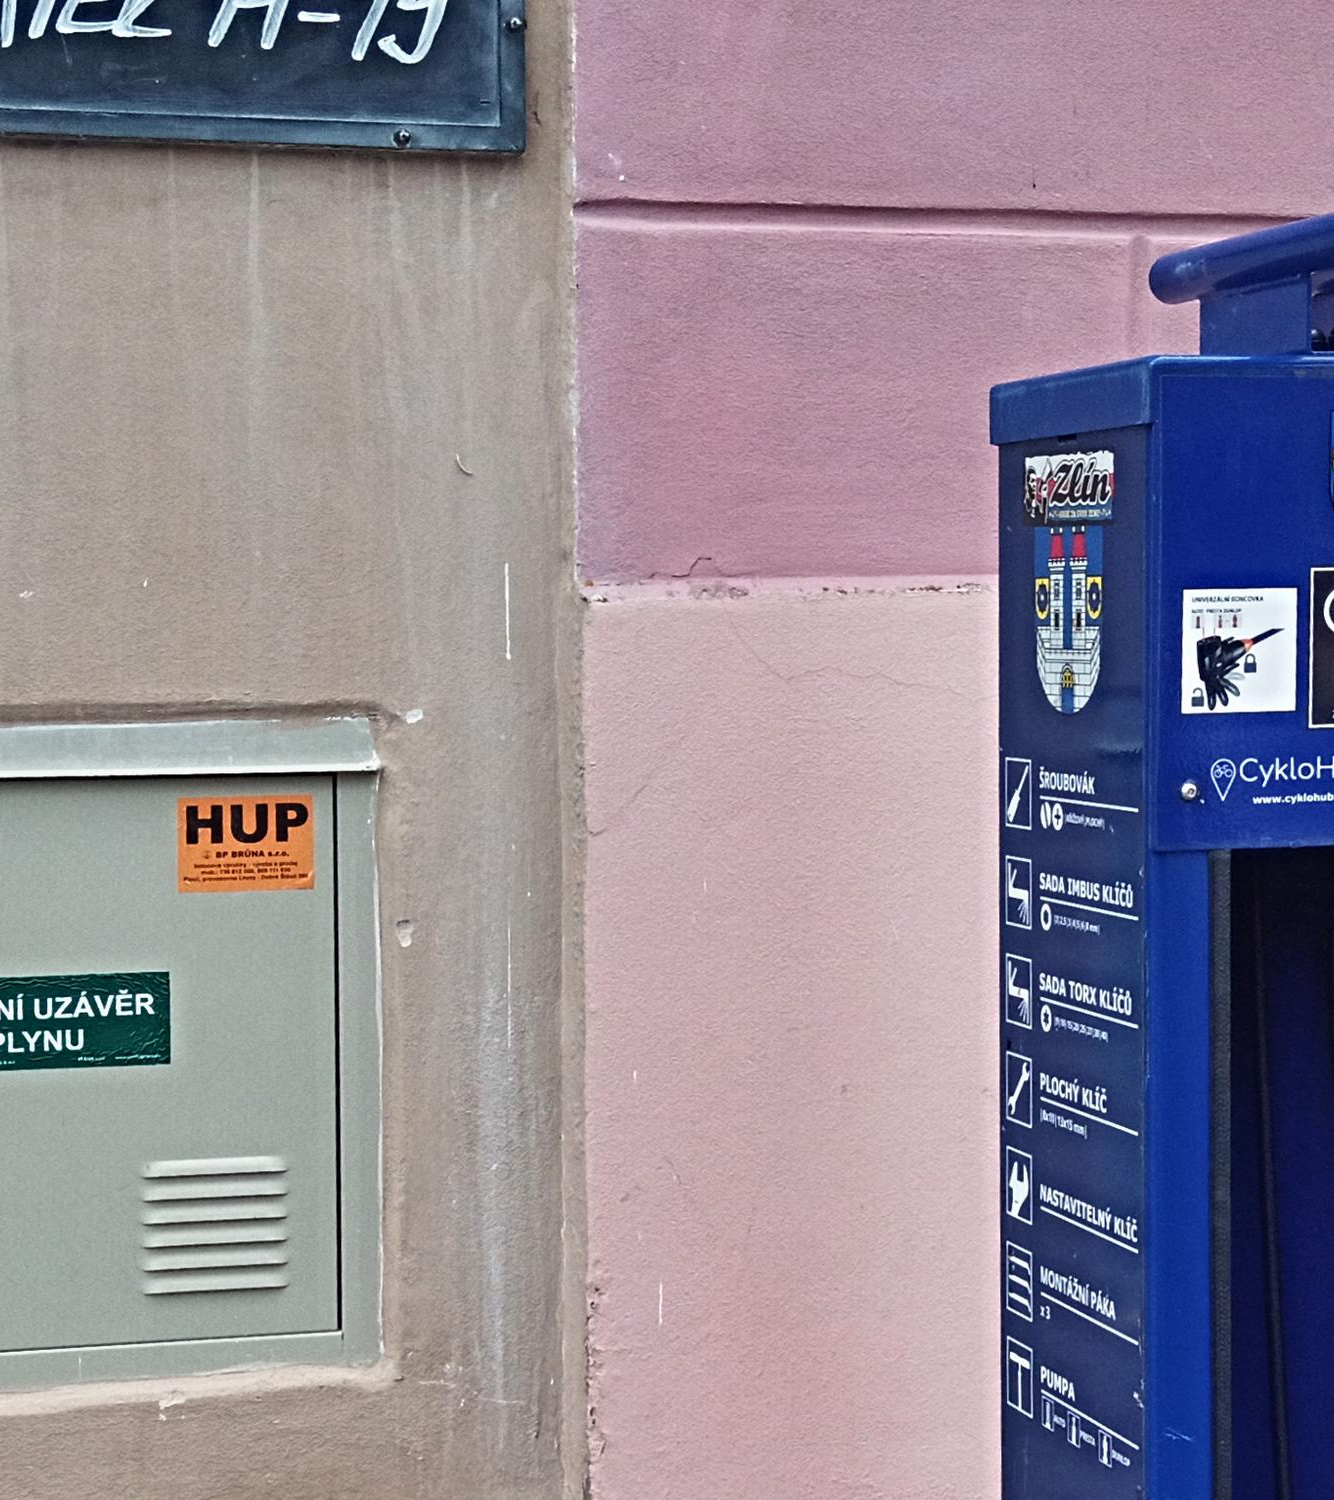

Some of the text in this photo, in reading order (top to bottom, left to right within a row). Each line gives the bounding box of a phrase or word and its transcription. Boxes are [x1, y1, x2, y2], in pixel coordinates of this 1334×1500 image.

[1050, 459, 1111, 505] Zlín
[1039, 766, 1095, 795] ŠROUBOVÁK
[185, 803, 309, 845] HUP
[1039, 872, 1133, 908] SADA IMBUS KLÍČŮ
[33, 989, 155, 1019] UZÁVĚR
[1039, 972, 1132, 1016] SADA TORX KLÍČŮ
[1039, 1072, 1107, 1113] PLOCHÝ KLÍČ
[1039, 1183, 1138, 1243] NASTAVITELNÝ KLÍČ
[1039, 1265, 1116, 1320] MONTÁŽNÍ PÁKA
[1040, 1365, 1076, 1402] PUMPA
